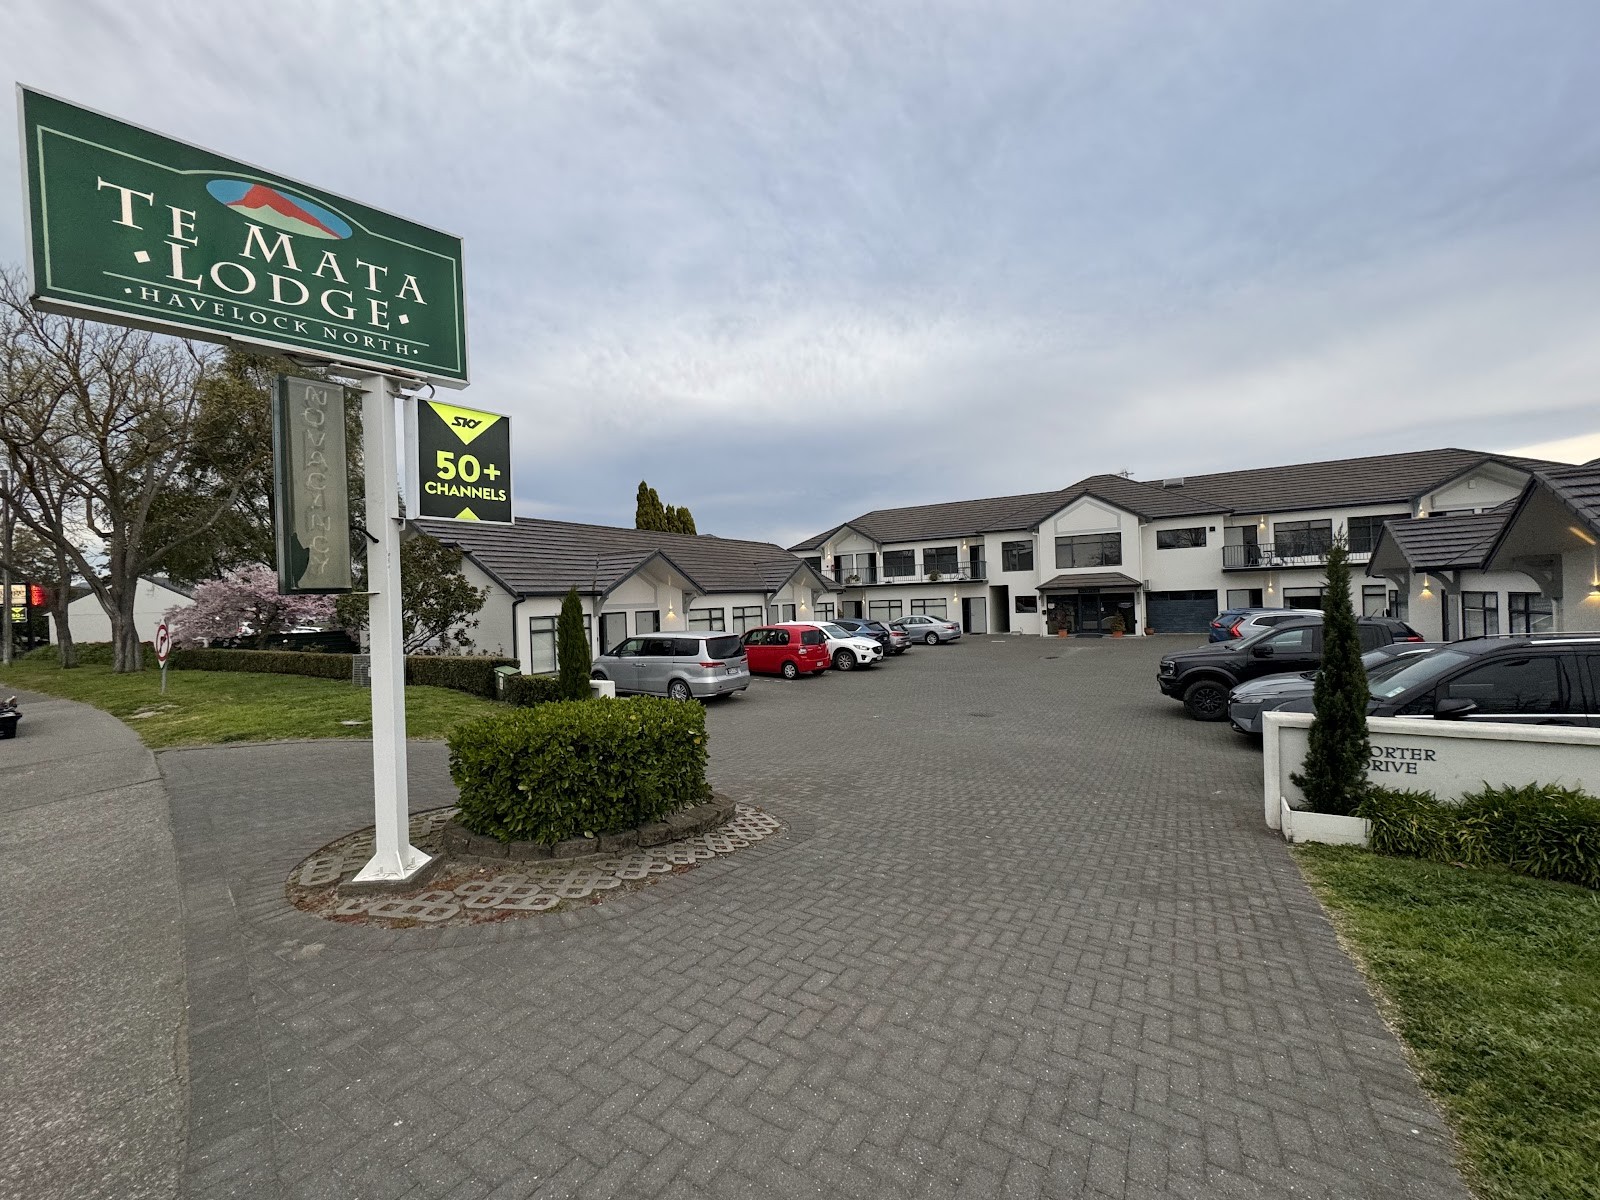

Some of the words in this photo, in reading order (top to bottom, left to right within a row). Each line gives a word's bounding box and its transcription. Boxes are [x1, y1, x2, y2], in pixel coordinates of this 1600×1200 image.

[97, 176, 199, 246] TE
[239, 222, 427, 306] MATA
[164, 241, 391, 330] LODGE
[139, 286, 309, 334] HAVELOCK
[323, 327, 408, 355] NORTH
[451, 416, 483, 429] SKY
[436, 450, 501, 483] 50+
[424, 481, 507, 502] CHANNELS
[1370, 745, 1436, 761] ORTER
